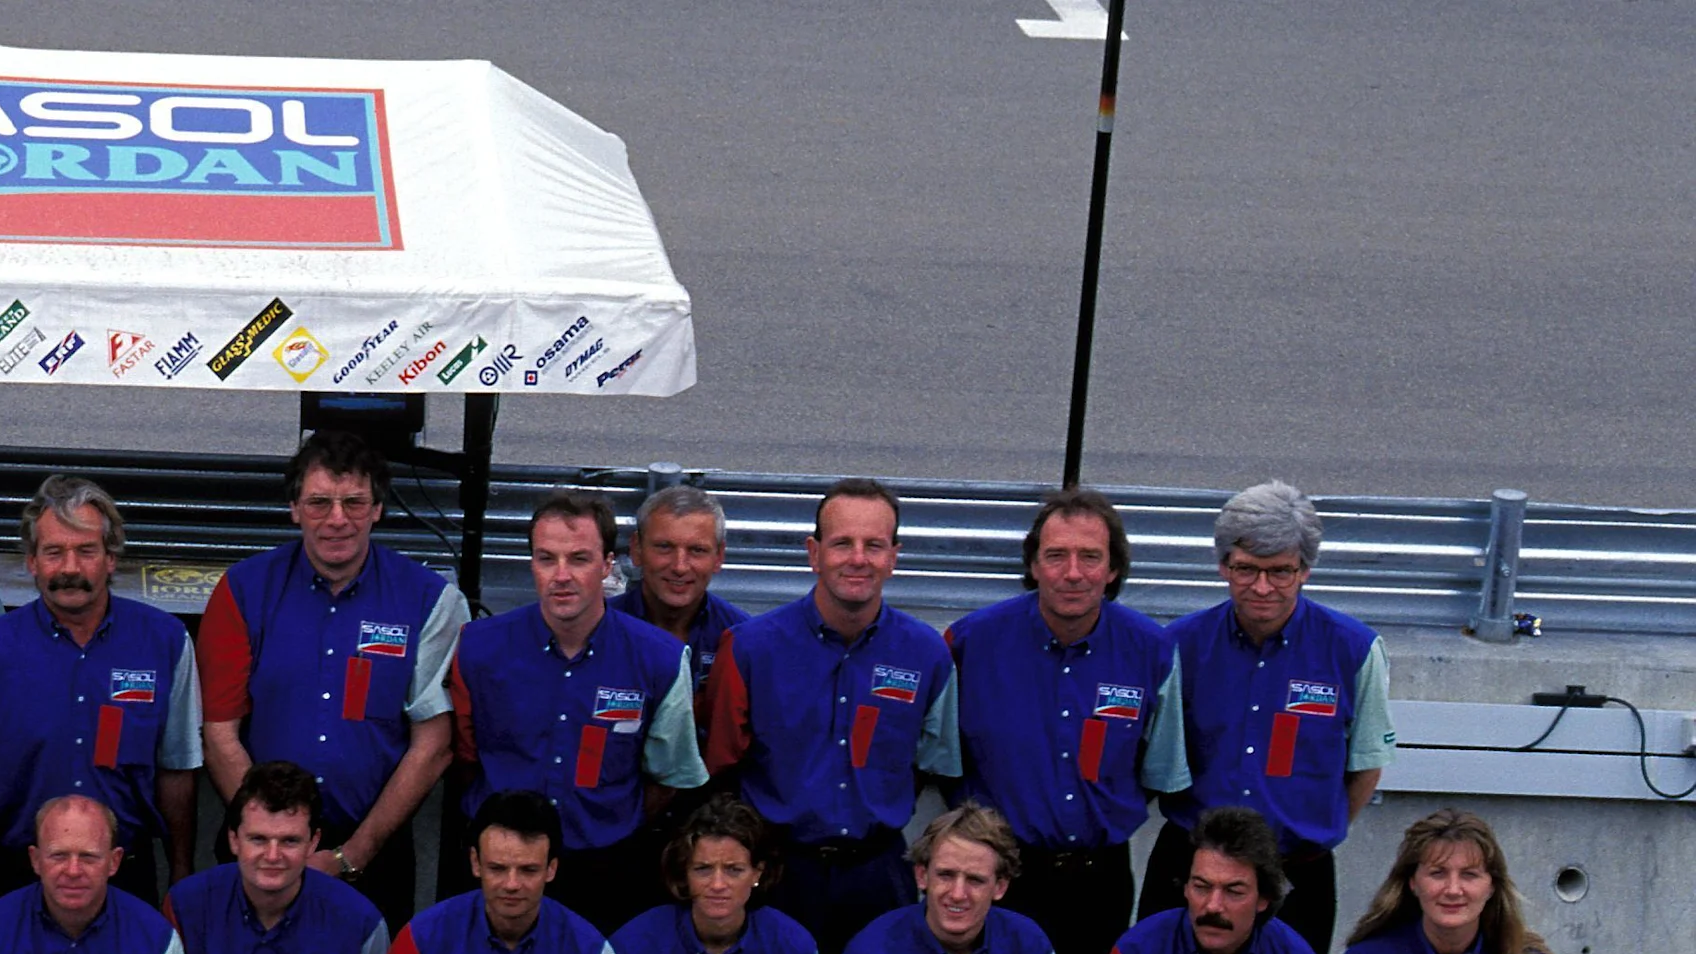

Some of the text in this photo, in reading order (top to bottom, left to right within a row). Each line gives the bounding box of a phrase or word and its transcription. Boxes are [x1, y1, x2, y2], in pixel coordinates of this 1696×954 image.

[245, 302, 284, 344] MEDIC
[536, 315, 590, 369] osama
[113, 340, 156, 378] FASTAR
[154, 332, 200, 374] FIAMM
[333, 319, 399, 384] GOODYEAR
[398, 340, 447, 385] Kibon
